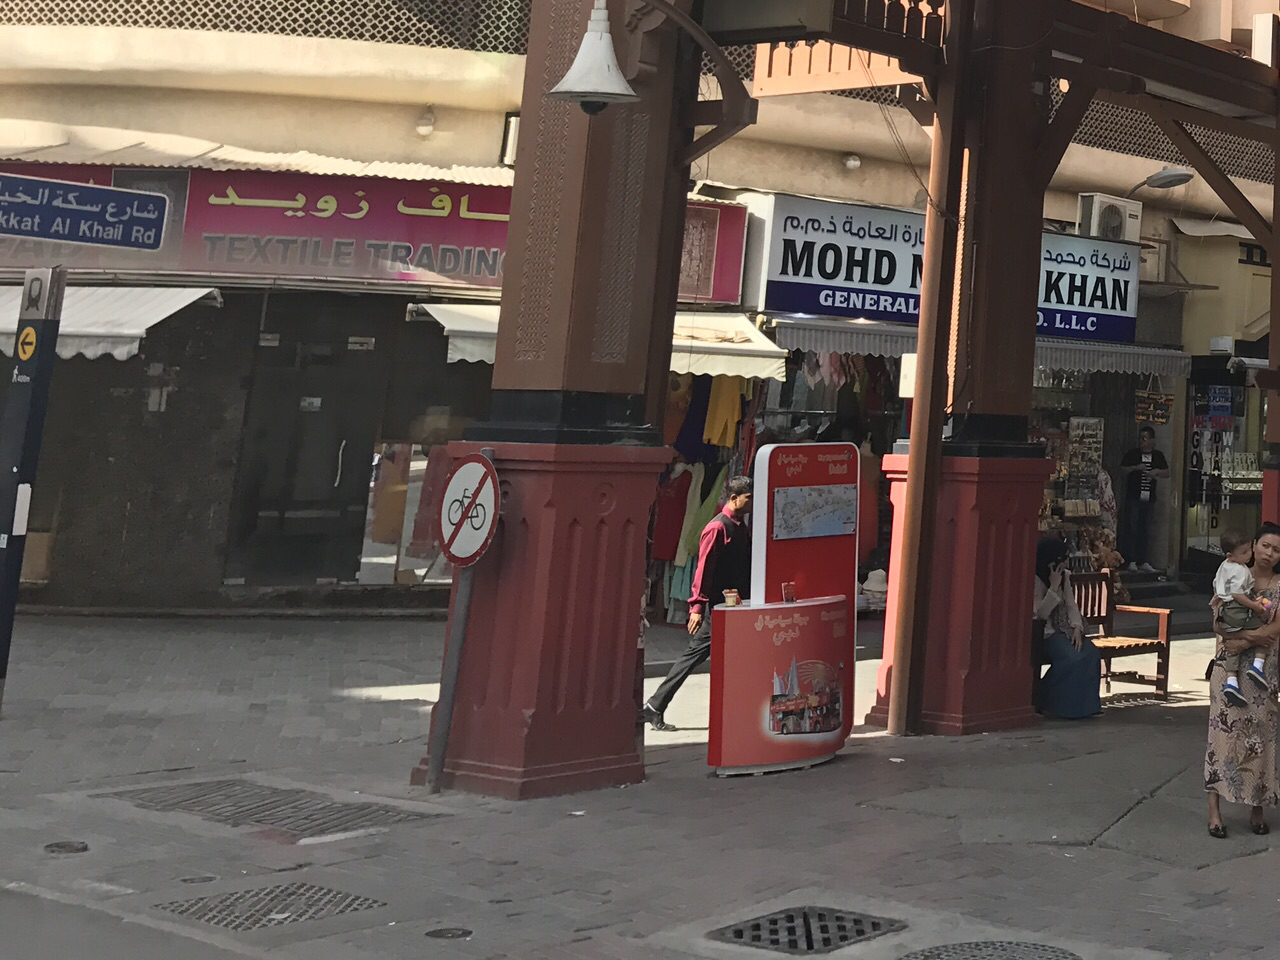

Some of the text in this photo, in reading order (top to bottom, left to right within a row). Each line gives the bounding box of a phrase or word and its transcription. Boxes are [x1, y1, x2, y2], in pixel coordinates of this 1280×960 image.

[51, 190, 102, 213] سكة
[105, 200, 159, 223] شارع
[208, 185, 370, 219] زويد
[51, 217, 70, 235] Al
[78, 220, 124, 242] Khail
[131, 228, 156, 245] Rd
[842, 215, 898, 242] العامة
[202, 231, 506, 279] TEXTILE TRADIN
[1043, 249, 1087, 267] محمد
[1090, 249, 1131, 273] شركة
[779, 238, 897, 286] MOHD
[1043, 270, 1130, 312] KHAN
[819, 289, 919, 315] GENERAL
[1055, 313, 1097, 331] L.L.C
